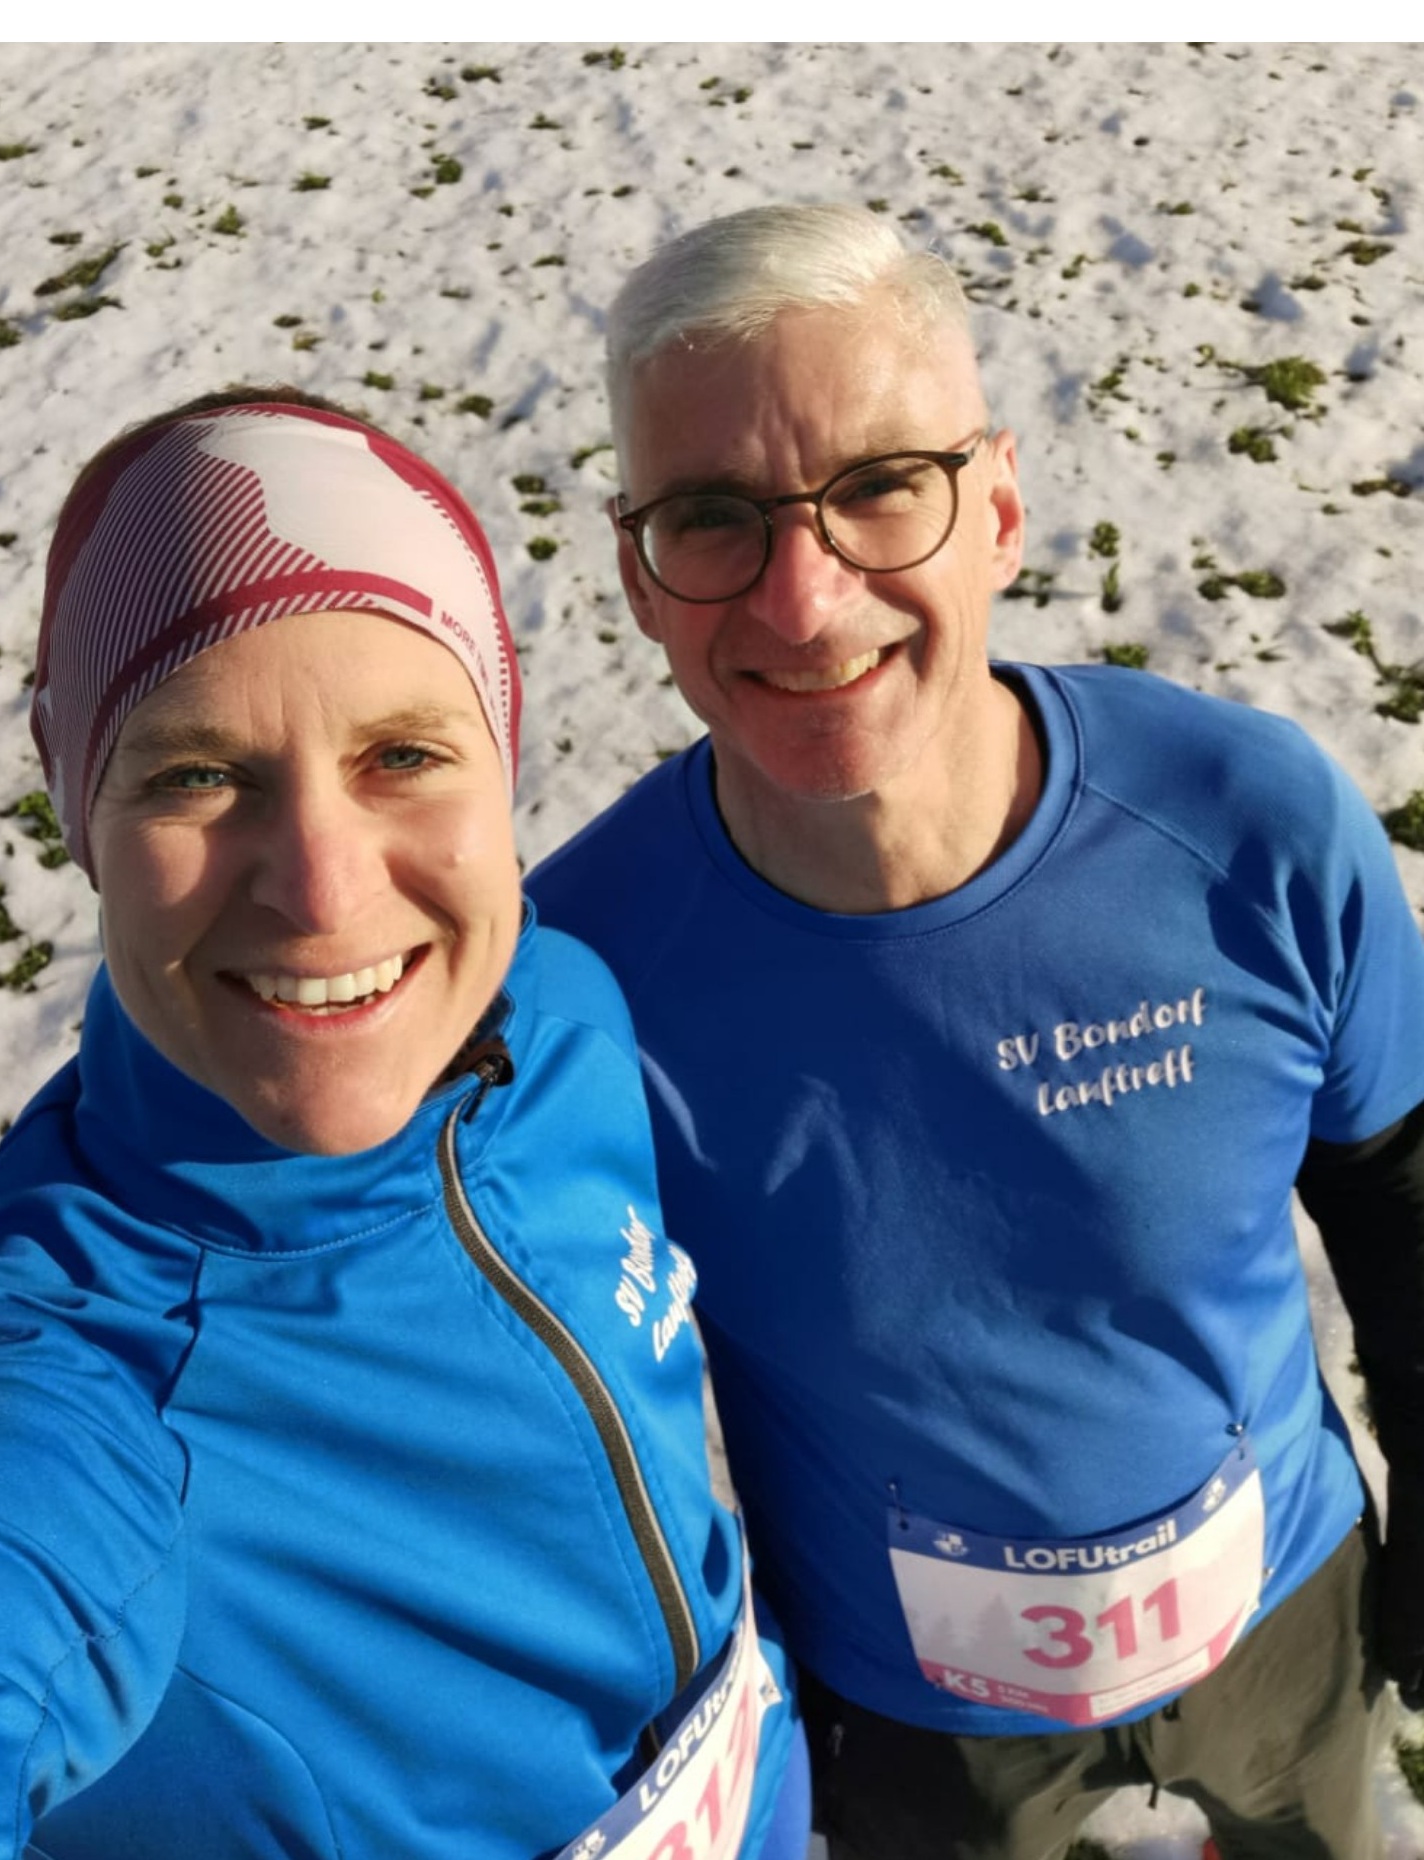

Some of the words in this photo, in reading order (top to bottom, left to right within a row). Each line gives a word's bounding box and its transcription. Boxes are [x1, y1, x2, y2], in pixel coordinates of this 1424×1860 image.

[440, 610, 477, 657] MORE
[997, 1032, 1039, 1070] SV
[1054, 987, 1206, 1061] Bondorf
[1038, 1044, 1195, 1116] Lauftreff
[1003, 1519, 1176, 1571] LOFUtrail
[1021, 1578, 1181, 1669] 311
[943, 1668, 990, 1699] K5
